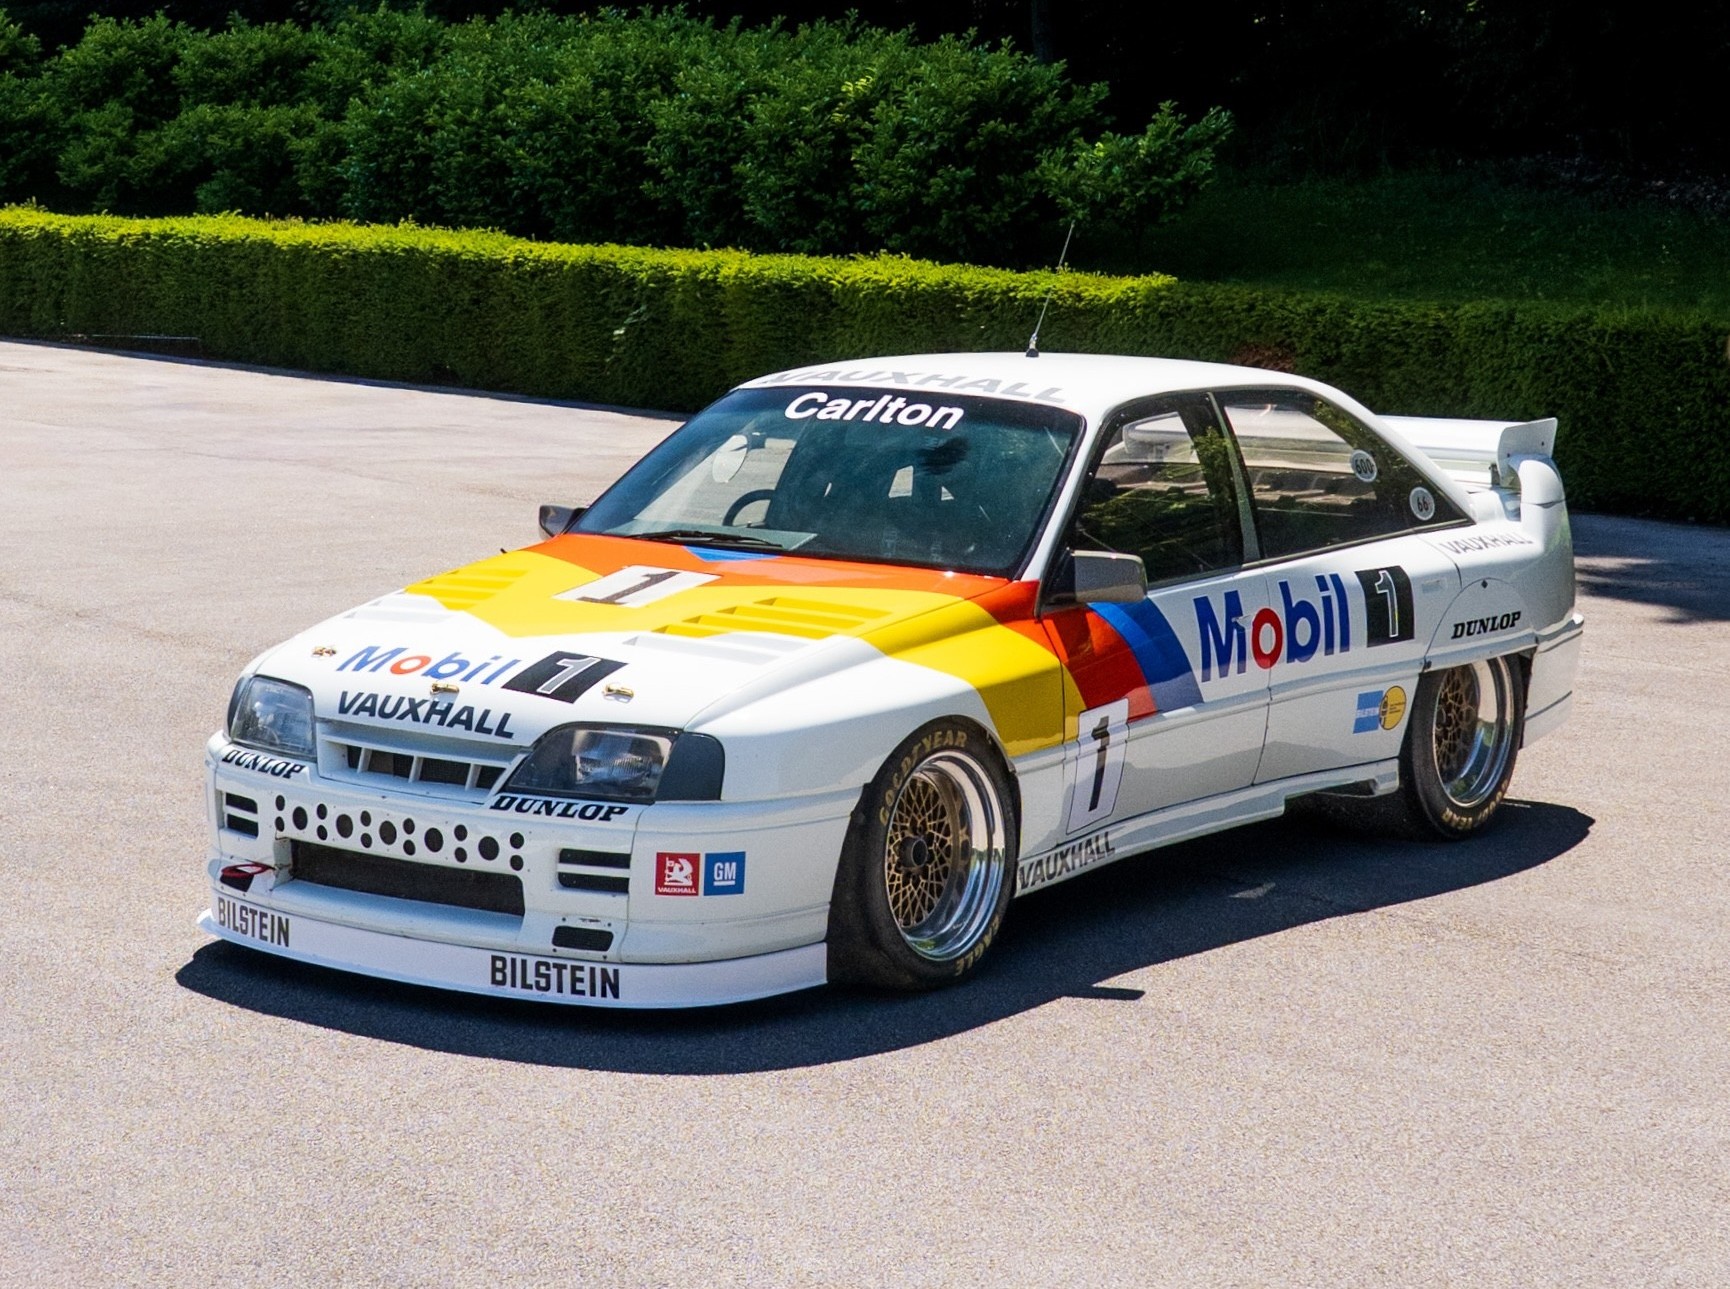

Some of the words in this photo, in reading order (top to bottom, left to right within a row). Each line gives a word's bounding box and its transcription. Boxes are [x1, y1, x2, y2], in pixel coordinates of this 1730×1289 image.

[768, 371, 1067, 403] VAUXHALL
[784, 392, 964, 430] Carlton
[1440, 533, 1534, 554] VAUXHALL
[576, 571, 682, 606] 1
[1193, 573, 1350, 683] Mobil
[1375, 570, 1399, 638] 1
[1451, 611, 1521, 640] DUNLOP
[336, 645, 521, 686] Mobil
[536, 656, 600, 695] 1
[338, 691, 516, 740] VAUXHALL
[222, 749, 306, 779] DUNLOP
[1088, 716, 1110, 812] 1
[489, 795, 629, 821] DUNLOP
[713, 861, 737, 881] GM
[1018, 831, 1115, 890] VAUXHALL
[657, 886, 697, 894] VAUXHALL
[218, 896, 290, 948] BILSTEIN
[490, 954, 620, 999] BILSTEIN
